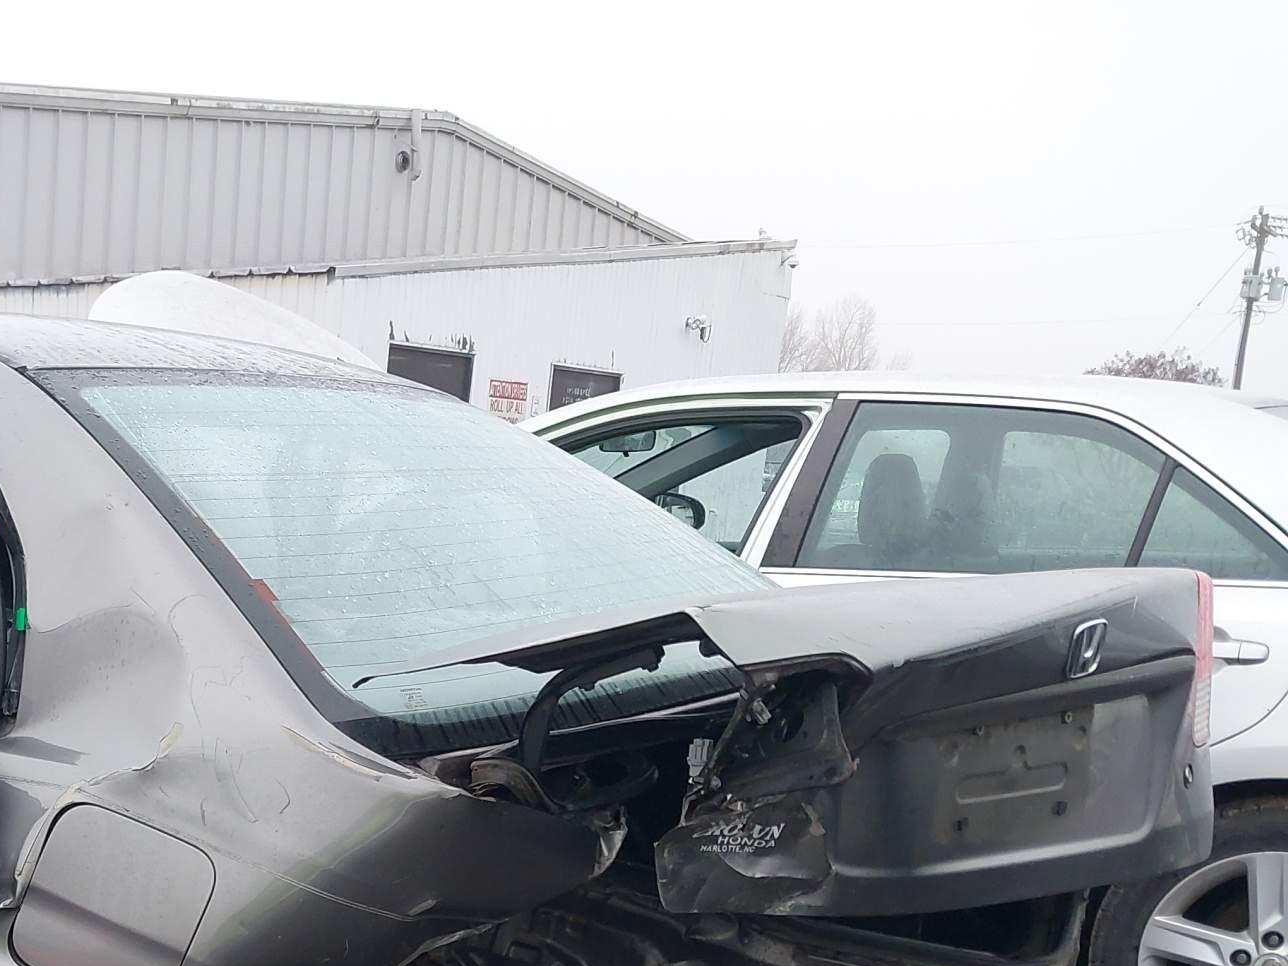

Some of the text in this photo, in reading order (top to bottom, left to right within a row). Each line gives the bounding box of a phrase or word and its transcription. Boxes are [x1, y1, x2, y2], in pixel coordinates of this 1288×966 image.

[490, 399, 524, 415] ROLL UP ALL
[717, 836, 776, 848] HONDA
